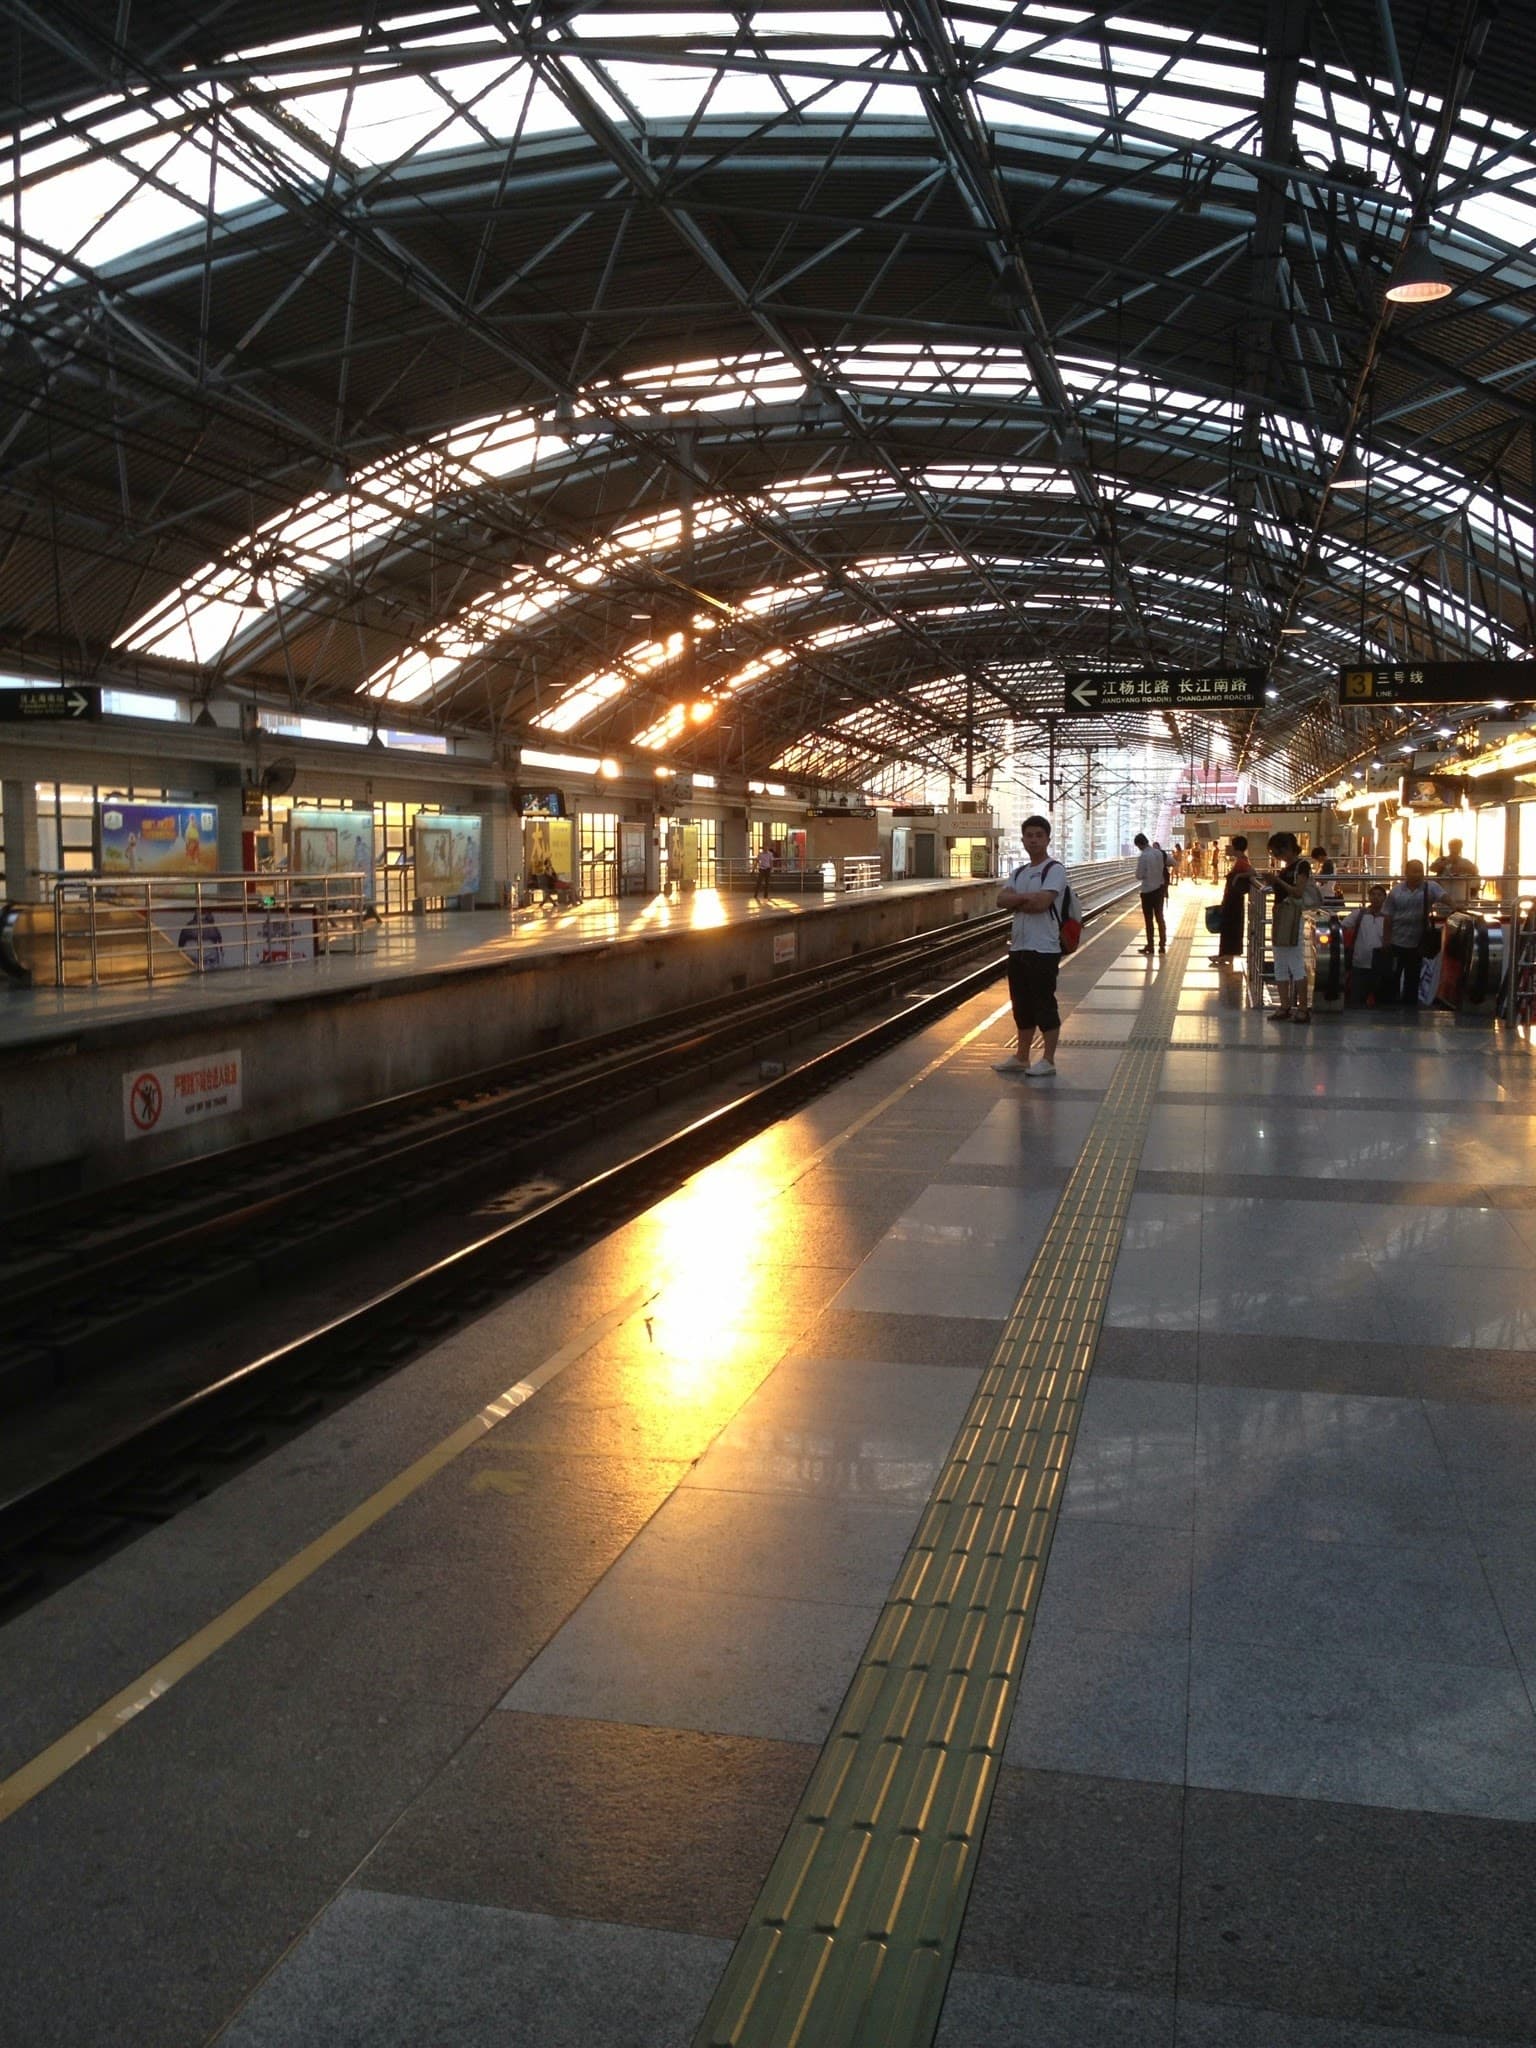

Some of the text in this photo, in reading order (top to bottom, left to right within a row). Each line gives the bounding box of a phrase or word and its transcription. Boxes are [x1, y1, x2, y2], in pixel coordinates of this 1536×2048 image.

[1351, 674, 1367, 695] 3
[1376, 671, 1424, 684] 三号线
[1102, 678, 1248, 695] 江杨北路 长江南路
